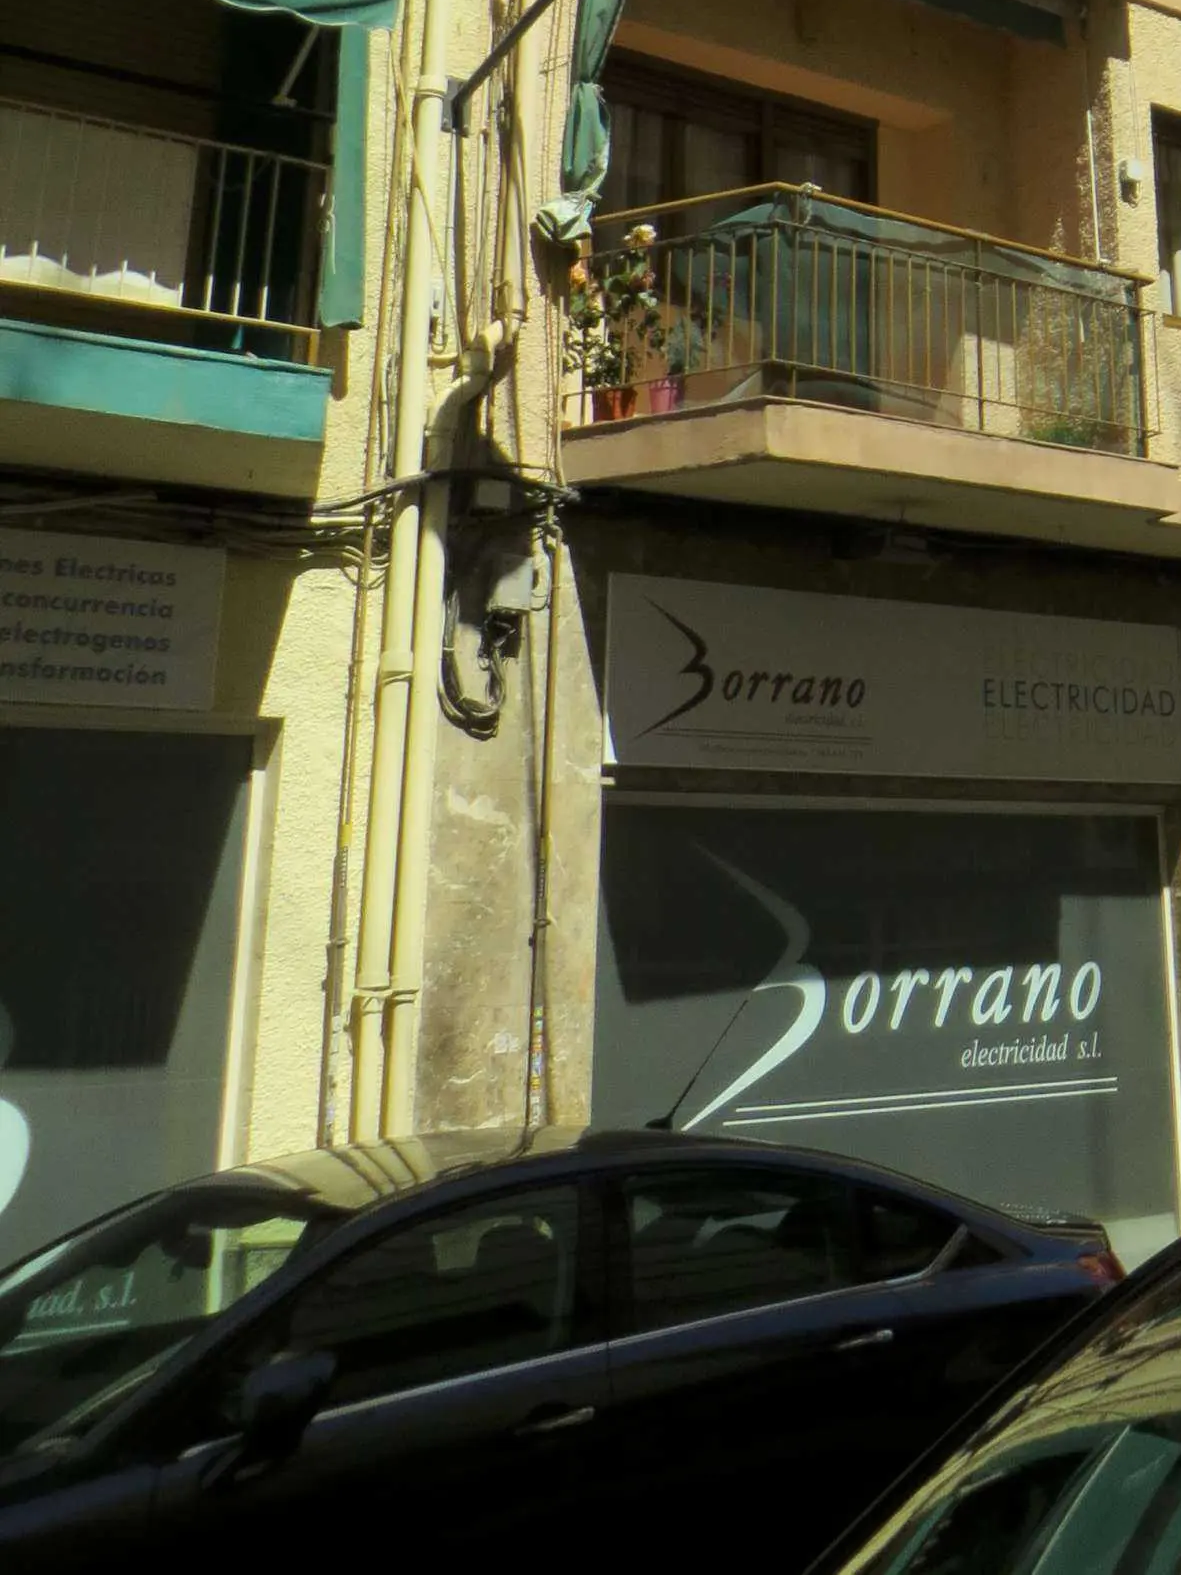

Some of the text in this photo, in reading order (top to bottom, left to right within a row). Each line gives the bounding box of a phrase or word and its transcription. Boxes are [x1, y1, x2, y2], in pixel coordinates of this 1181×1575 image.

[2, 591, 174, 619] concurrencia
[983, 678, 1176, 717] ELECTRICIDAD
[960, 1030, 1103, 1069] electricidad s.l.
